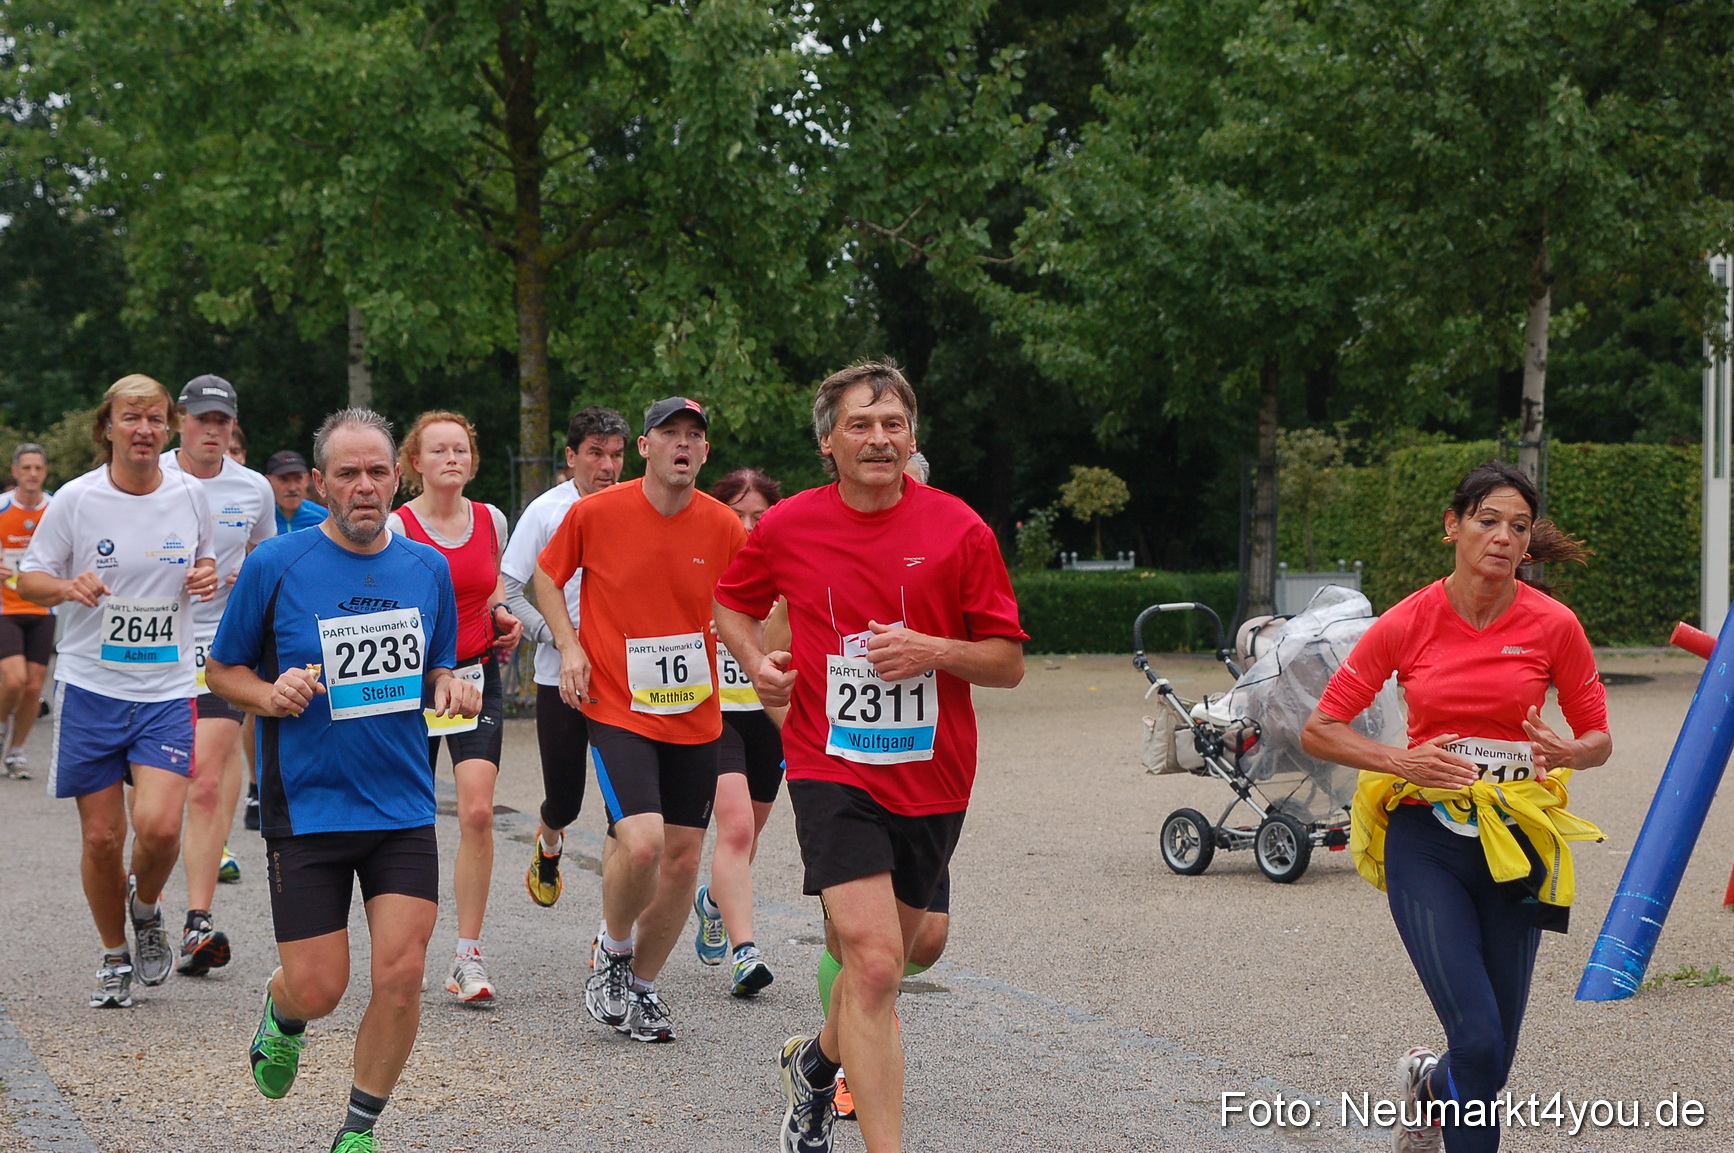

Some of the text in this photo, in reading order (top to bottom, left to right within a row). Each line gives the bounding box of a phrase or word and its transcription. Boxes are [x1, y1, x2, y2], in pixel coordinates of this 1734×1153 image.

[349, 596, 401, 609] ERTEL
[109, 615, 174, 643] 2644
[322, 620, 409, 639] PARTL Neumarkt
[124, 649, 157, 661] Achim
[335, 633, 421, 680] 2233
[628, 642, 693, 654] PARTL Neumarkt
[1501, 645, 1522, 655] RUN
[655, 654, 689, 685] 16
[829, 665, 865, 679] PARTL
[361, 684, 406, 702] Stefan
[649, 690, 695, 704] Matthias
[837, 682, 924, 723] 2311
[847, 732, 915, 752] Wolfgang
[1474, 746, 1527, 762] Neumarkt
